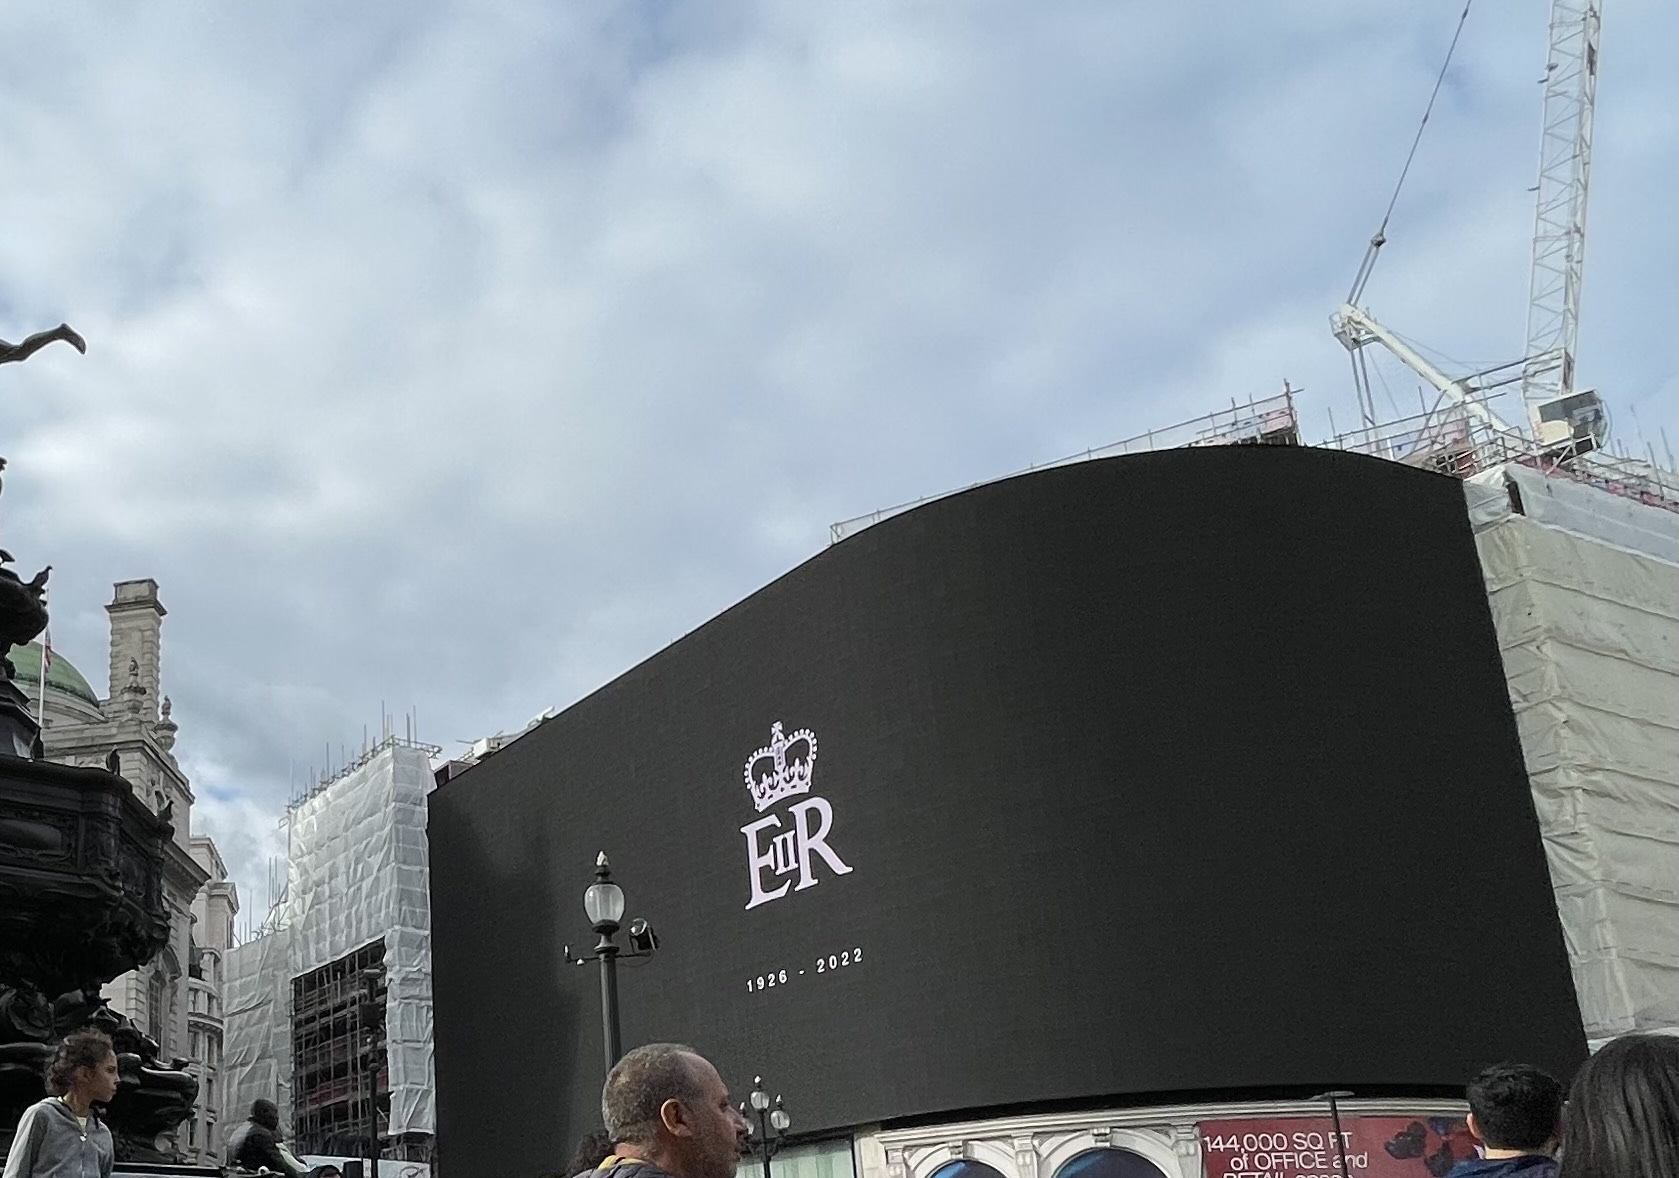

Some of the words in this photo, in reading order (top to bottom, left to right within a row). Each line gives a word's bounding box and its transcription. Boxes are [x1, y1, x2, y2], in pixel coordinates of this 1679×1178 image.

[746, 969, 788, 993] 1926
[816, 947, 863, 974] 2022
[1203, 1133, 1288, 1153] 144,000
[1293, 1132, 1325, 1150] SQ
[1230, 1153, 1250, 1171] of
[1254, 1151, 1329, 1170] OFFICE
